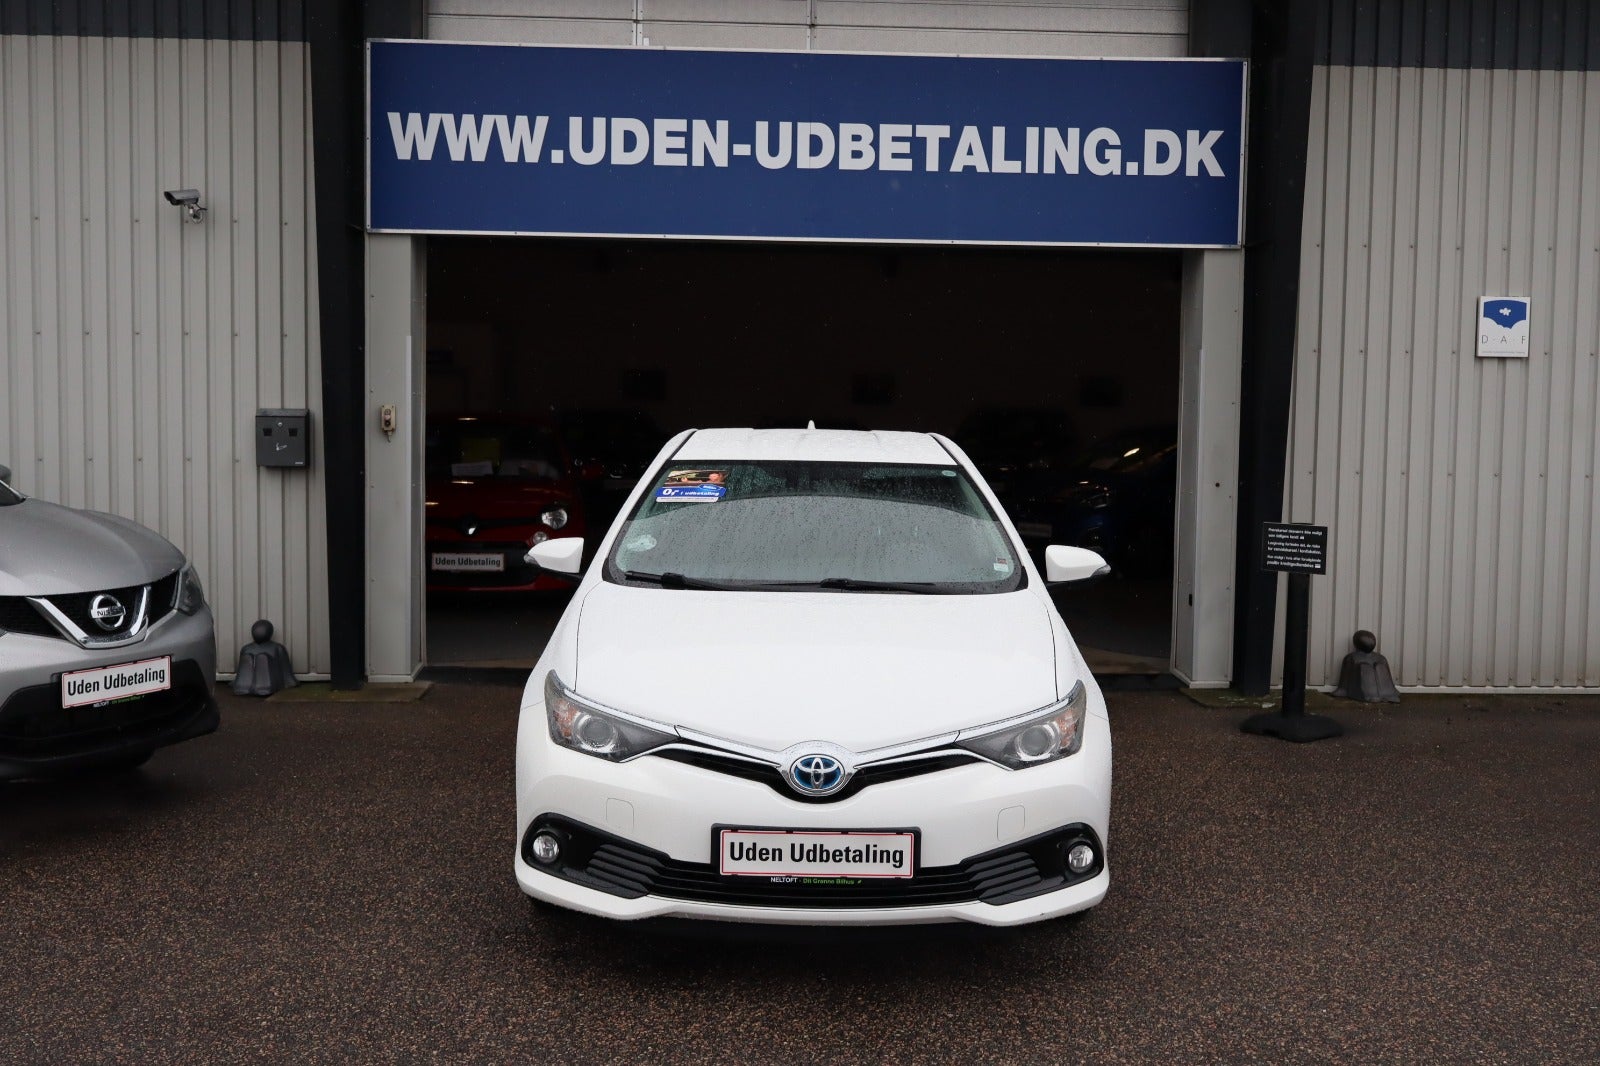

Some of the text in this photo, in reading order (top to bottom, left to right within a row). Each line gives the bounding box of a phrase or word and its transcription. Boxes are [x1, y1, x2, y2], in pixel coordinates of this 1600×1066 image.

[386, 111, 1225, 179] WWW.UDEN-UDBETALING.DK
[435, 557, 501, 567] Uden Udbetaling
[67, 667, 165, 696] Uden Udbetaling
[729, 842, 904, 869] Uden Udbetaling
